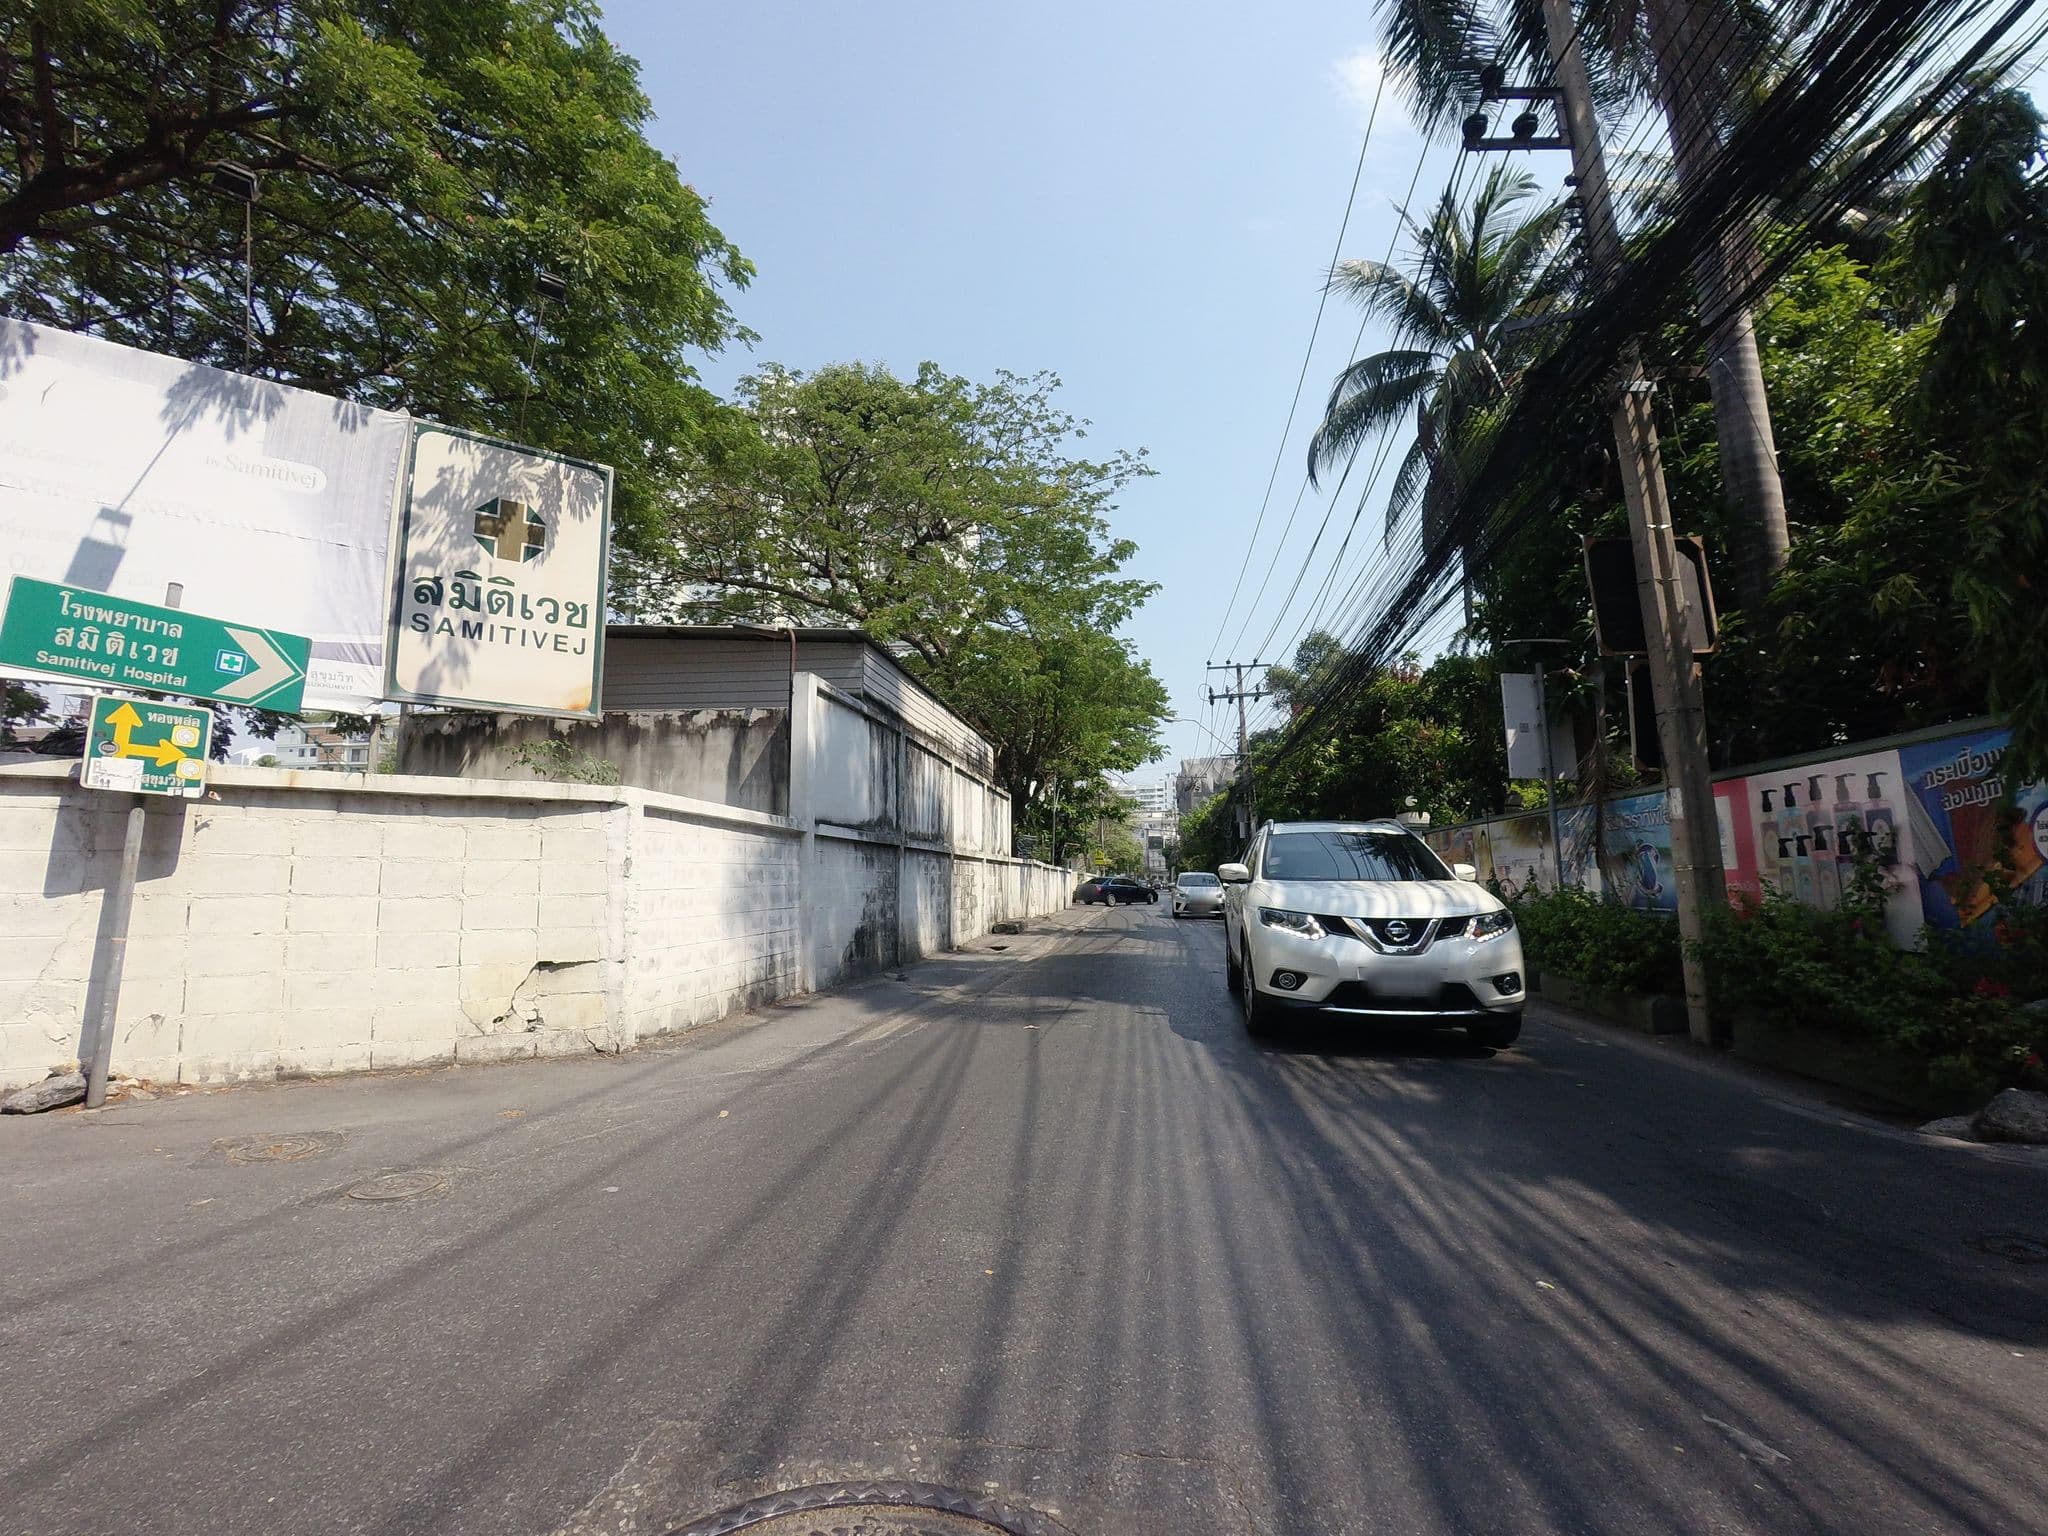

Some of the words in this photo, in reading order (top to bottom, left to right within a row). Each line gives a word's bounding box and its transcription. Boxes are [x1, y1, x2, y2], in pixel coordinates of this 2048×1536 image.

[223, 455, 318, 490] Samitivej
[58, 591, 183, 639] โรงพยาบาล
[412, 569, 589, 630] สมิติเวช
[54, 625, 179, 667] สมิติเวช
[410, 612, 587, 656] SAMITIVEJ
[35, 650, 116, 677] Samitivej
[123, 665, 188, 688] Hospital
[147, 711, 201, 728] ทองหล่อ
[140, 772, 186, 789] สุขุมวิท
